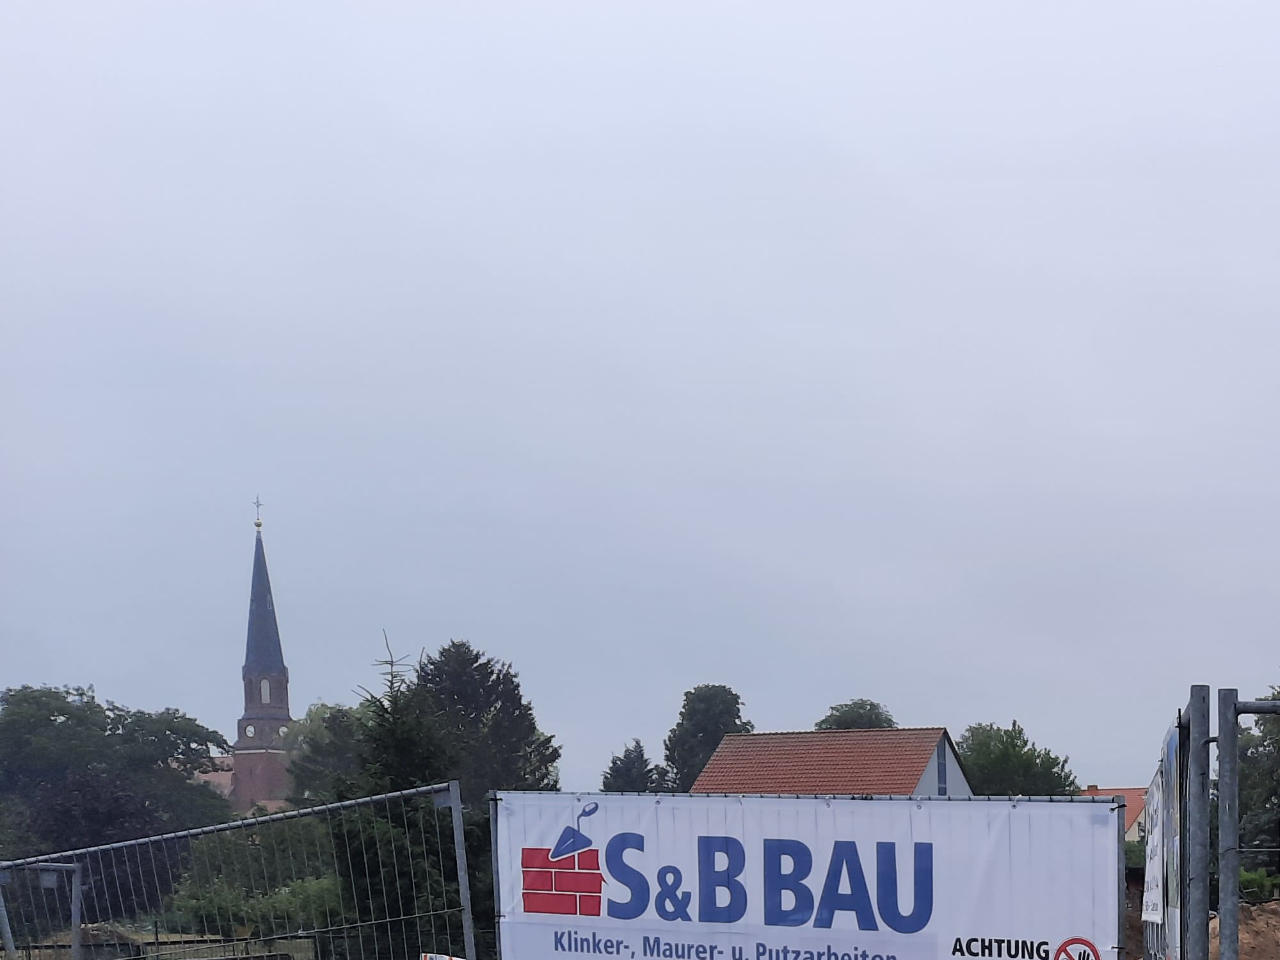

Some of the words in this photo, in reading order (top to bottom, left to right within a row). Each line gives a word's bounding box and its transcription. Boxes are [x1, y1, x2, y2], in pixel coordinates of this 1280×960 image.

[604, 832, 748, 924] S&B
[763, 838, 934, 935] BAU
[553, 930, 636, 960] Klinker-,
[951, 937, 1050, 960] ACHTUNG
